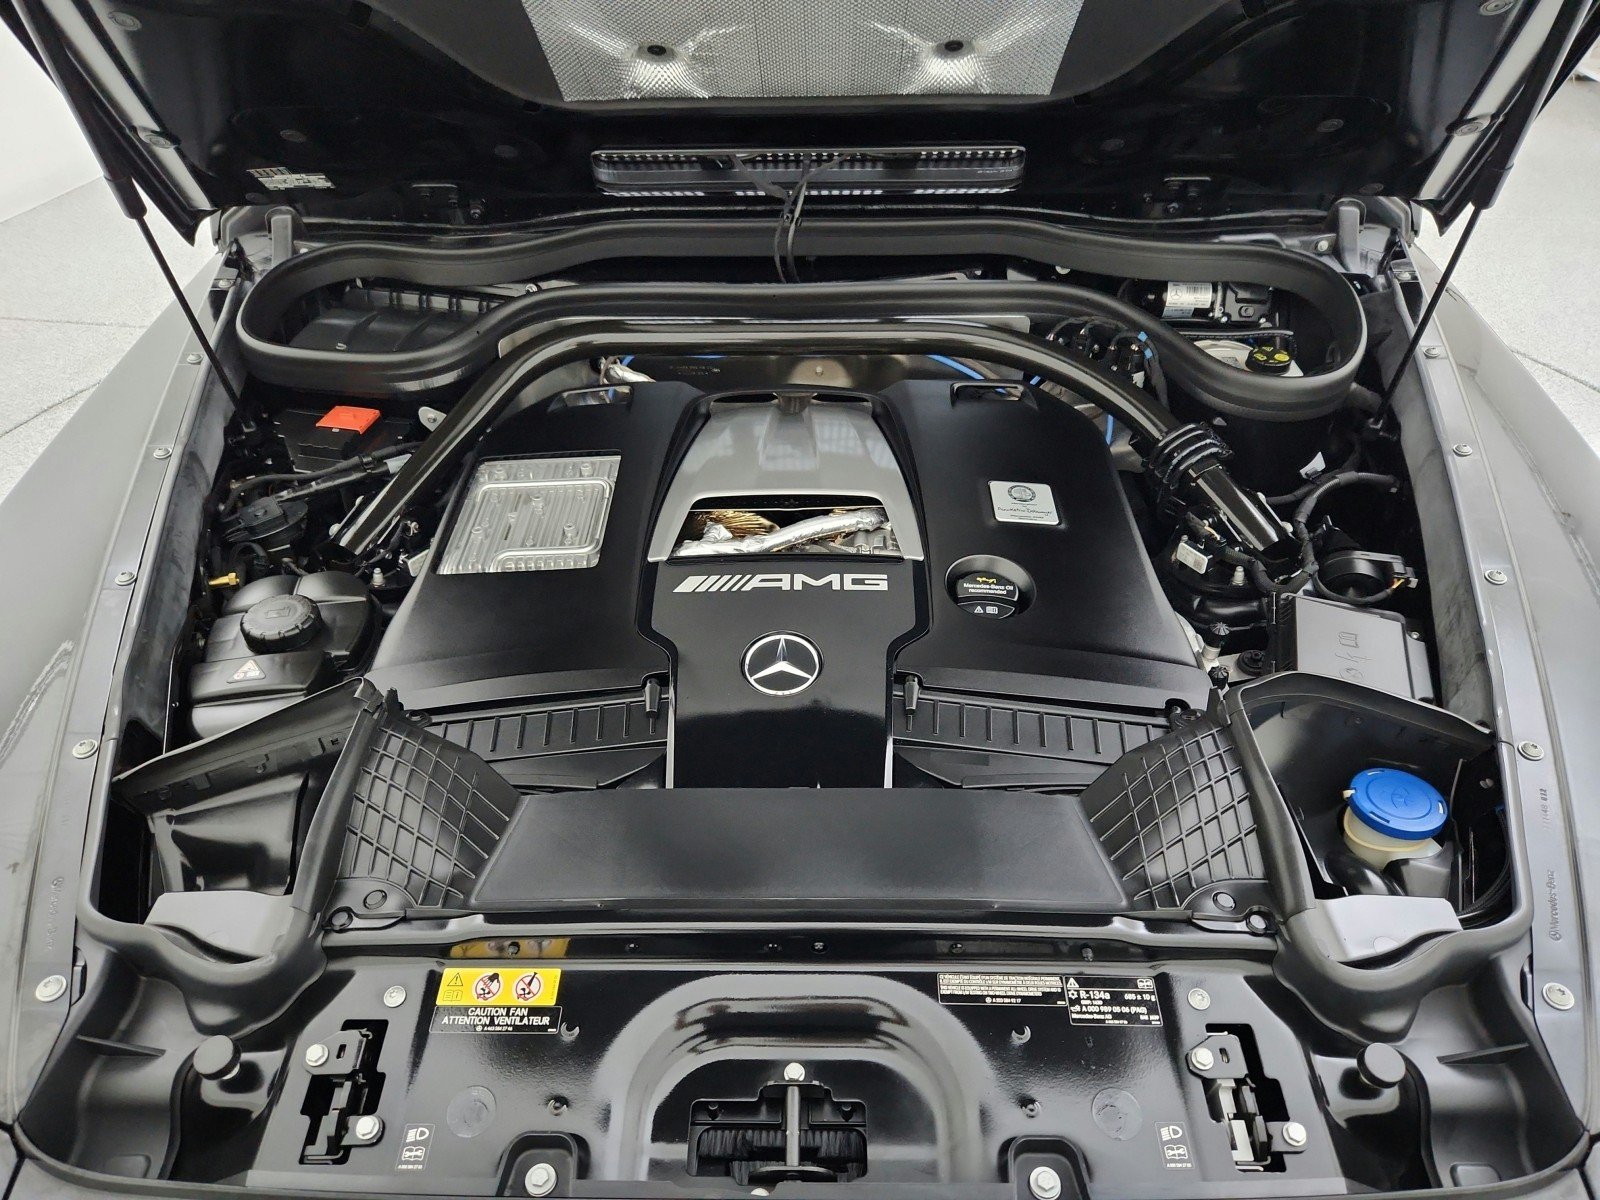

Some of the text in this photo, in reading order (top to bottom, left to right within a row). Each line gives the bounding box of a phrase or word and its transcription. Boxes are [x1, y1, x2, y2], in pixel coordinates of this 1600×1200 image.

[741, 573, 888, 591] AMG
[1080, 991, 1110, 1000] R-134a
[468, 1008, 528, 1016] CAUTION FAN
[442, 1016, 550, 1025] ATTENTION VENTILATEUR
